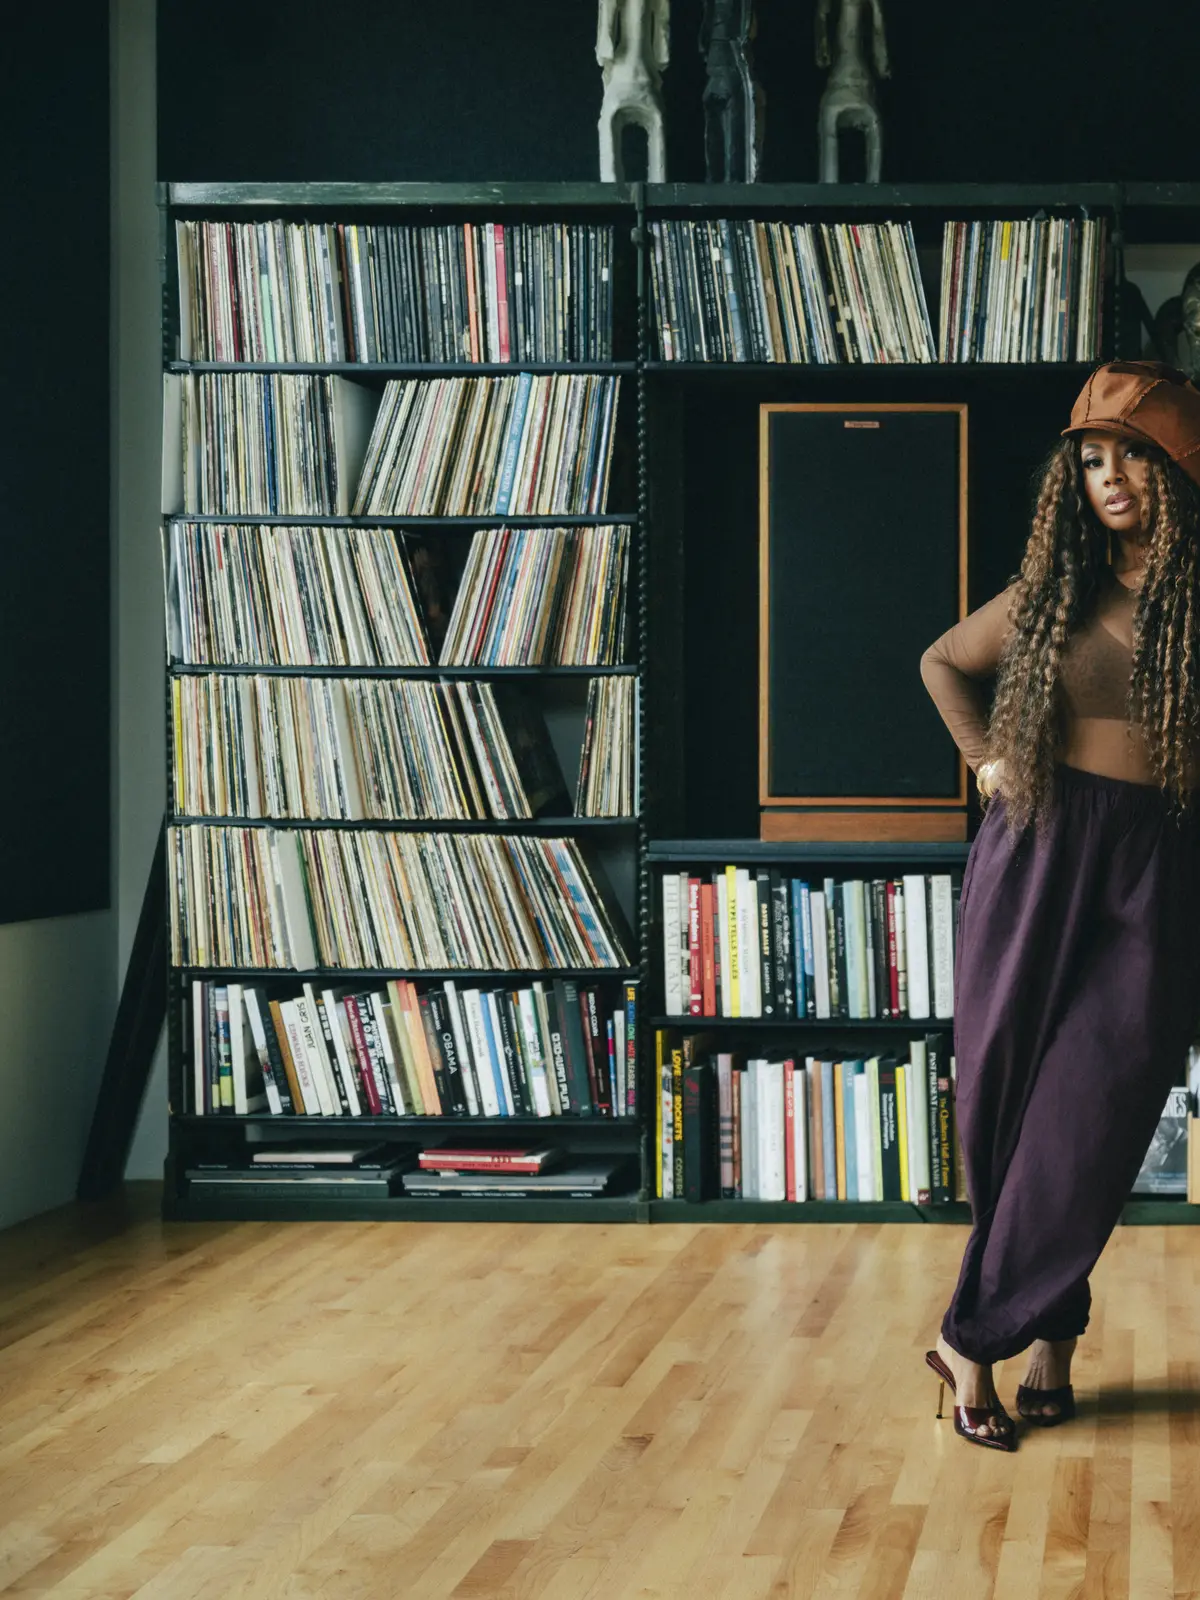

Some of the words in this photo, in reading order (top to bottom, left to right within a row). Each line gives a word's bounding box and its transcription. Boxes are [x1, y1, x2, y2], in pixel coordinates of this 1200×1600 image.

[665, 881, 678, 914] THE
[729, 898, 737, 921] TYPE
[691, 909, 700, 942] Modern
[761, 903, 769, 928] DAVID
[762, 928, 770, 956] BAILEY
[667, 919, 680, 995] VATICAN
[731, 954, 739, 980] TALES
[763, 962, 771, 994] Locations
[587, 992, 597, 1015] BRENDA
[626, 987, 636, 1001] LIFE
[590, 1015, 599, 1037] COLVIN
[626, 1002, 636, 1024] DEATH
[303, 1026, 316, 1049] JUAN
[370, 1019, 384, 1060] PHYSIQUE
[626, 1024, 636, 1040] LOVE
[288, 1023, 304, 1060] EDWARD
[297, 1060, 310, 1088] HICKS
[442, 1032, 458, 1075] OBAMA
[626, 1040, 636, 1058] HATE
[672, 1049, 682, 1076] LOVE
[929, 1052, 937, 1071] PAST
[626, 1058, 636, 1089] PLEASURE
[929, 1071, 938, 1106] PRESENT
[674, 1095, 683, 1141] ROCKETS
[942, 1142, 950, 1159] Hall
[676, 1157, 684, 1196] COVERS
[932, 1157, 941, 1188] BANIER
